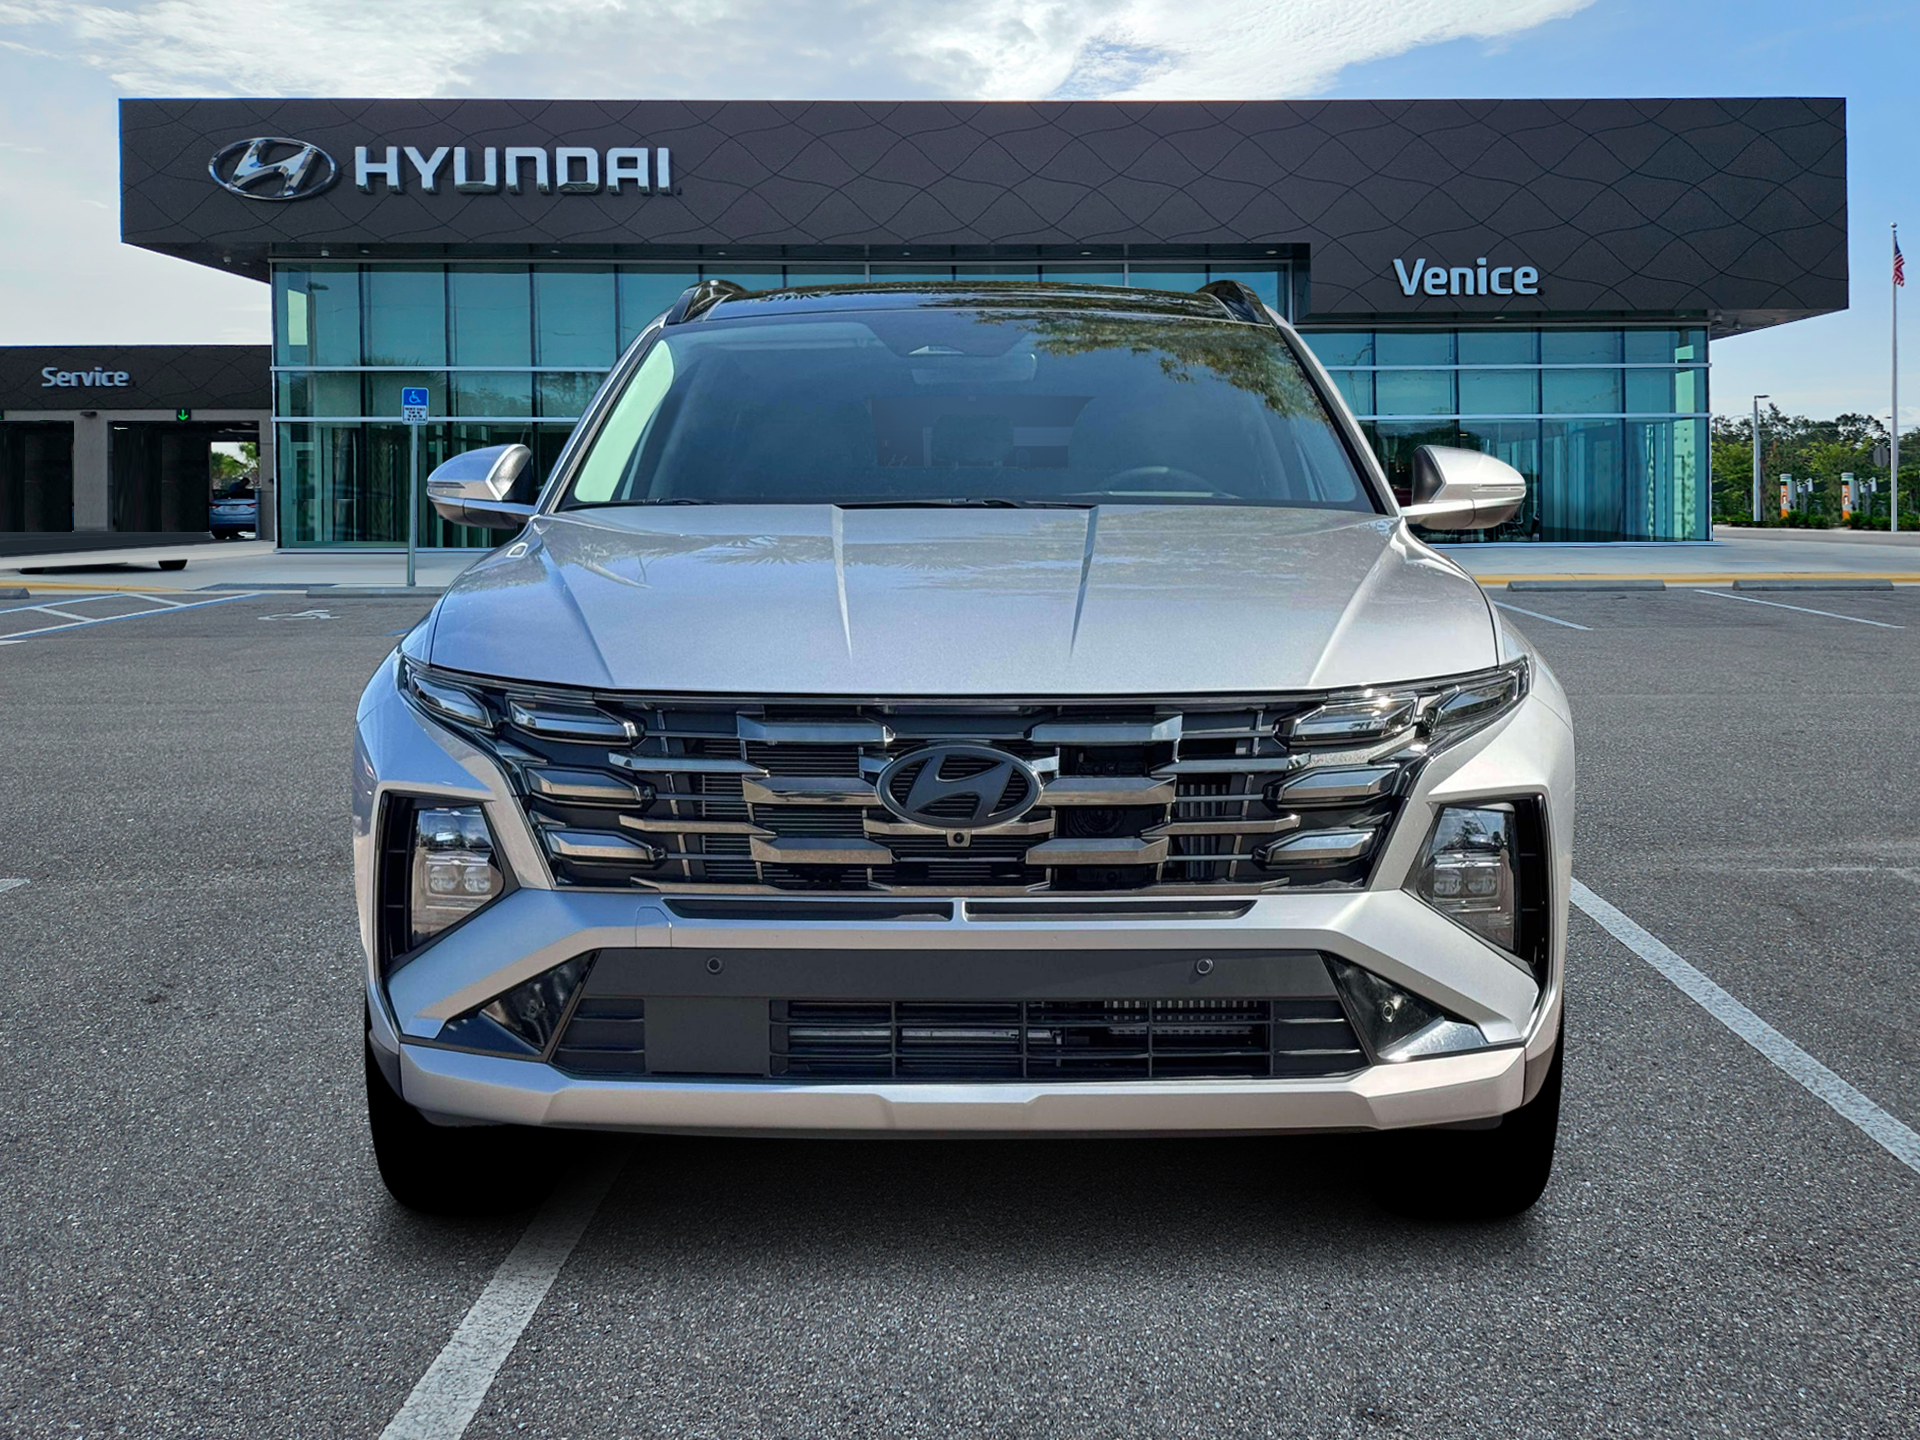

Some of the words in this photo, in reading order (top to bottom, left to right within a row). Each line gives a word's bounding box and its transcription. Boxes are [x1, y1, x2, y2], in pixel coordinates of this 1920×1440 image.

[354, 146, 670, 194] HYUNDAI
[1393, 257, 1539, 295] Venice
[41, 366, 129, 387] Service
